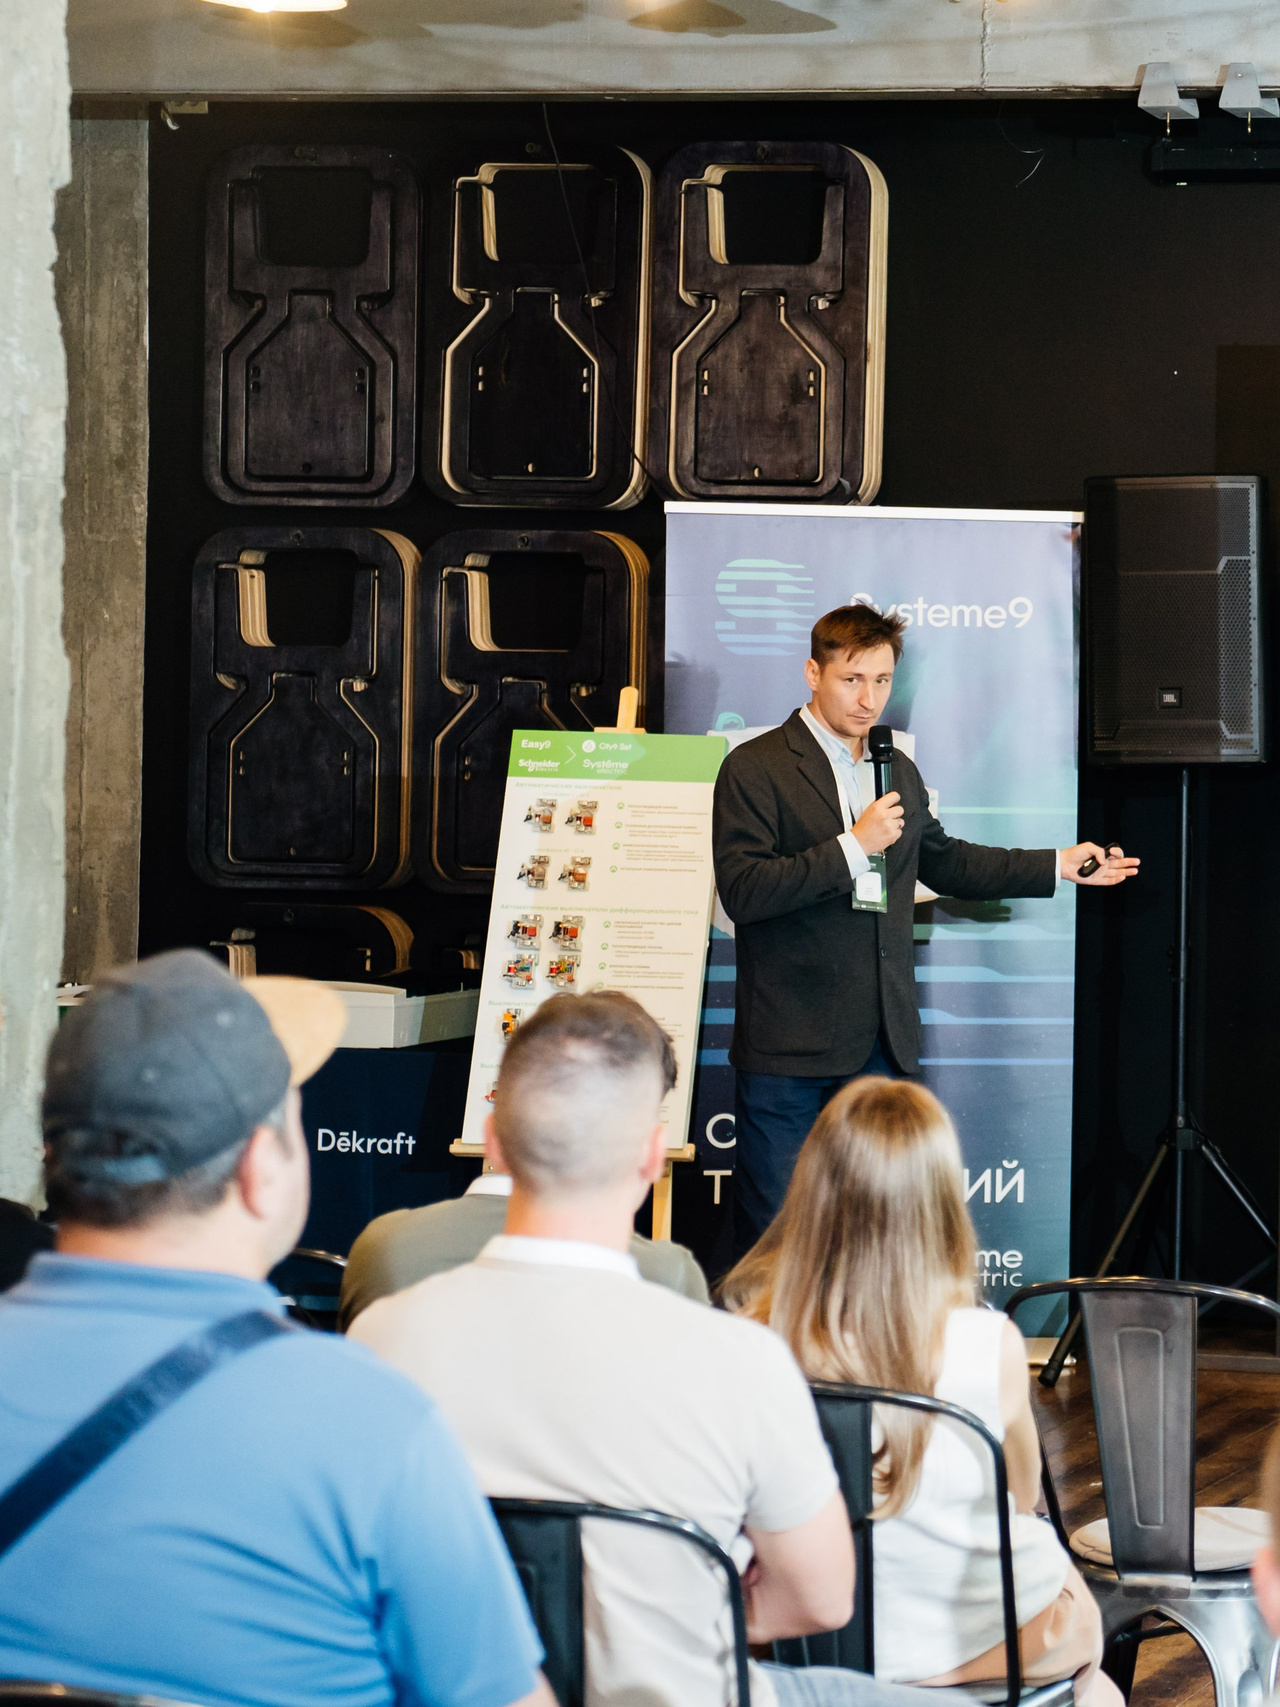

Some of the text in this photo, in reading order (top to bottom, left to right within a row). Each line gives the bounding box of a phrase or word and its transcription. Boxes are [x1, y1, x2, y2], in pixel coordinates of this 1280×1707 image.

[521, 739, 551, 750] Easy9
[518, 758, 560, 772] Schneider
[317, 1128, 417, 1155] Dēkraft
